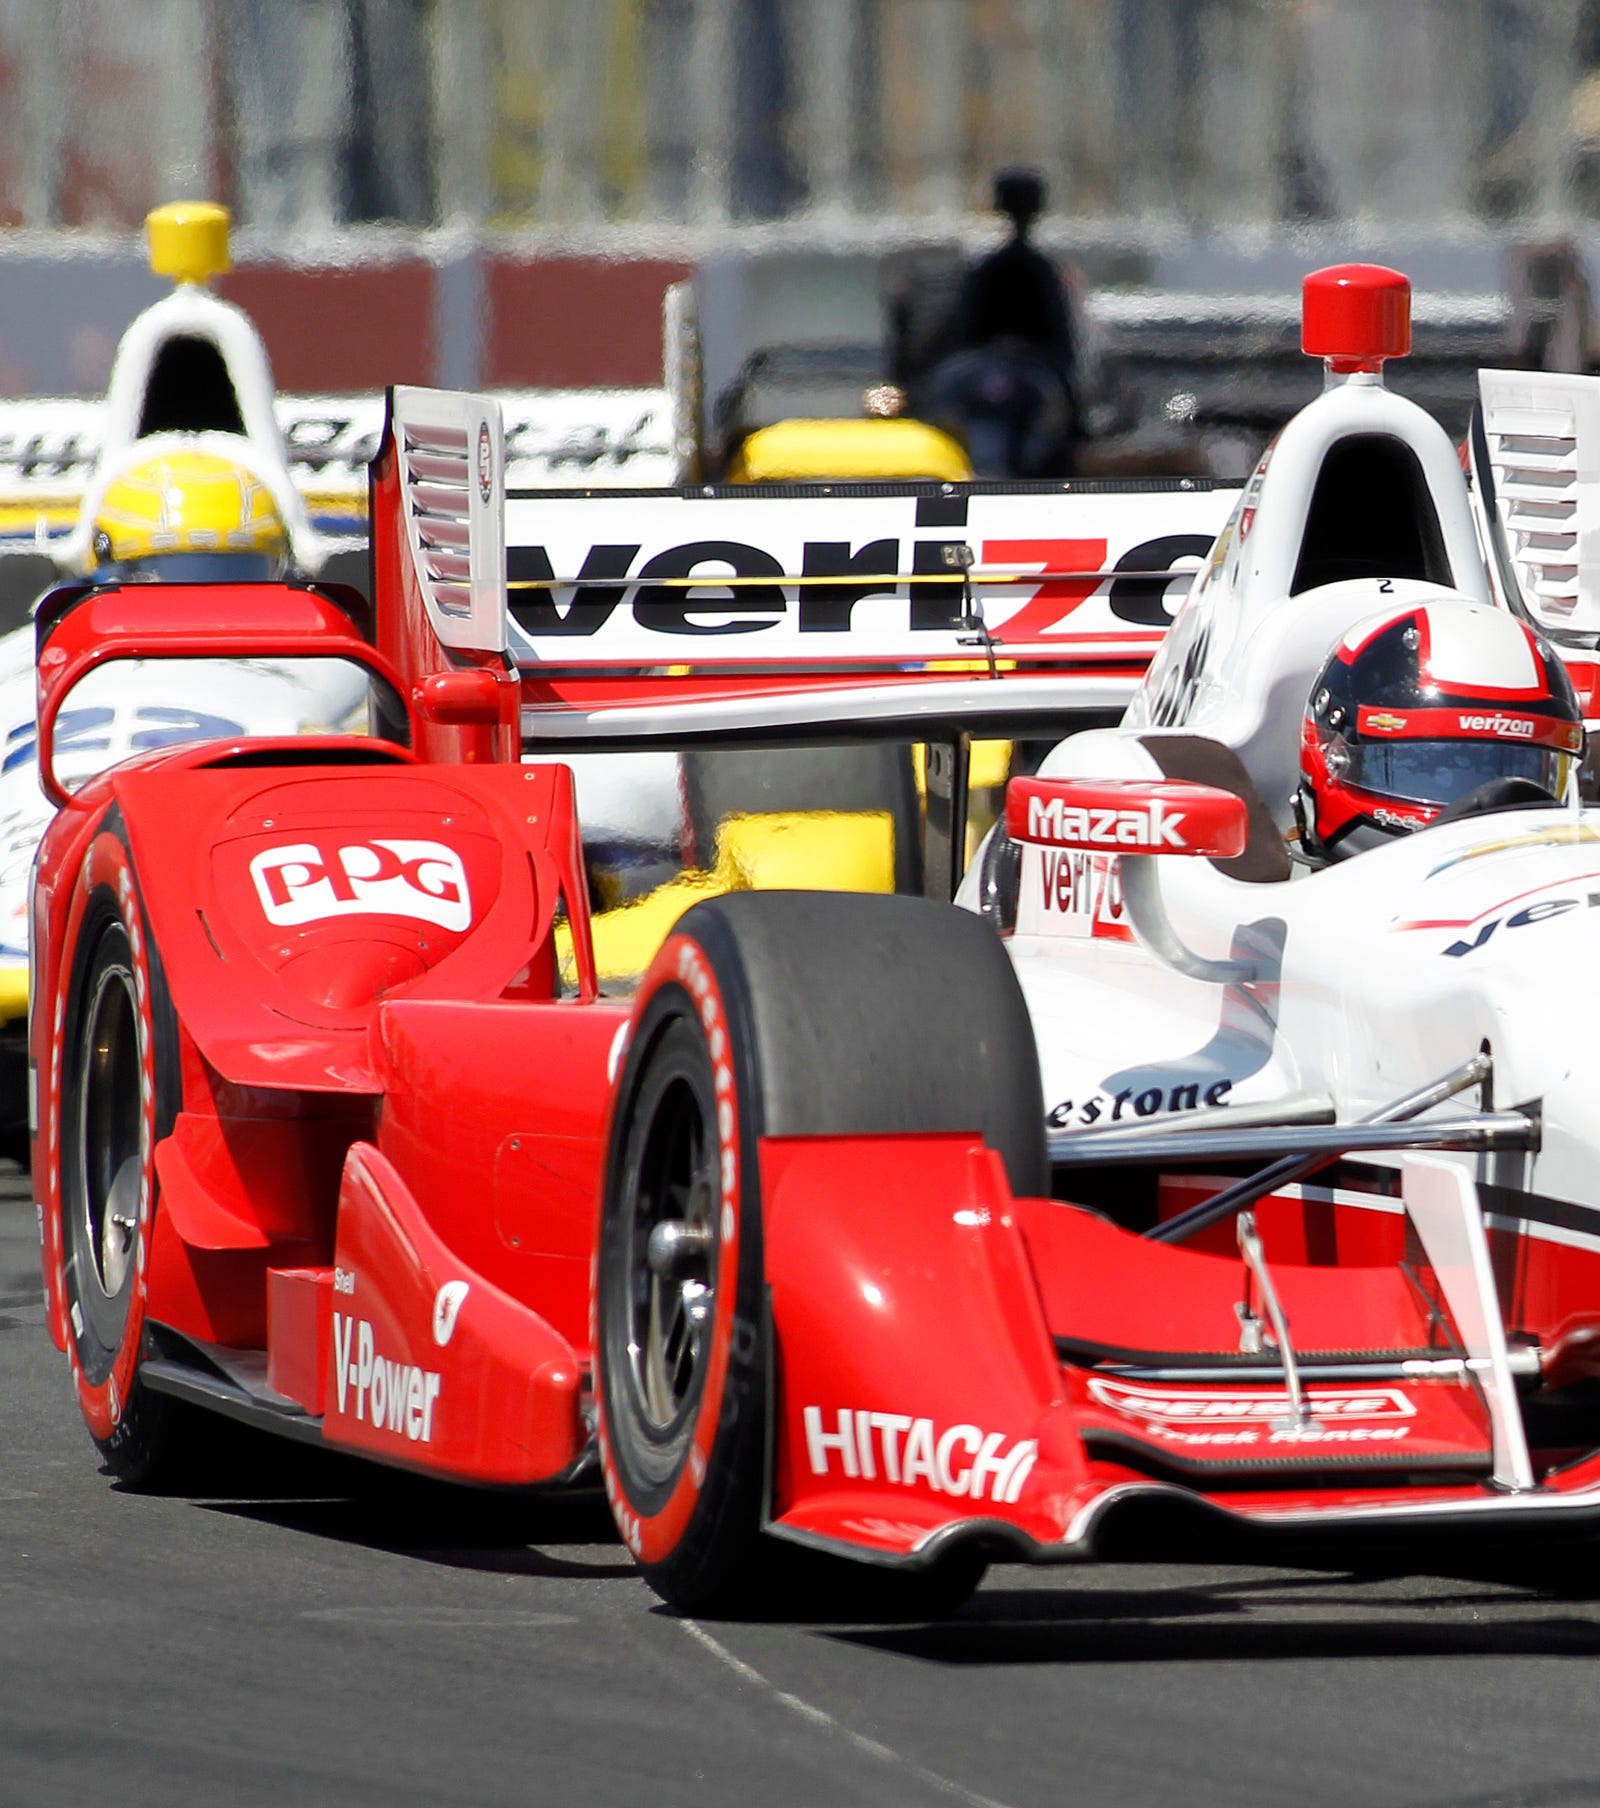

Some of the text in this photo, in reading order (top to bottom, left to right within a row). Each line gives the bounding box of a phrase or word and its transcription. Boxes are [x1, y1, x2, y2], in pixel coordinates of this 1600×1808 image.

[507, 497, 1218, 642] verizo
[1377, 579, 1394, 594] 2
[1458, 713, 1535, 739] verizon
[1027, 795, 1188, 847] Mazak
[260, 841, 463, 908] PPG
[1040, 850, 1136, 940] verizo
[1044, 1078, 1232, 1128] estone
[333, 1311, 441, 1442] V-Power
[803, 1405, 1040, 1504] HITACHI
[1267, 1424, 1410, 1445] Rental
